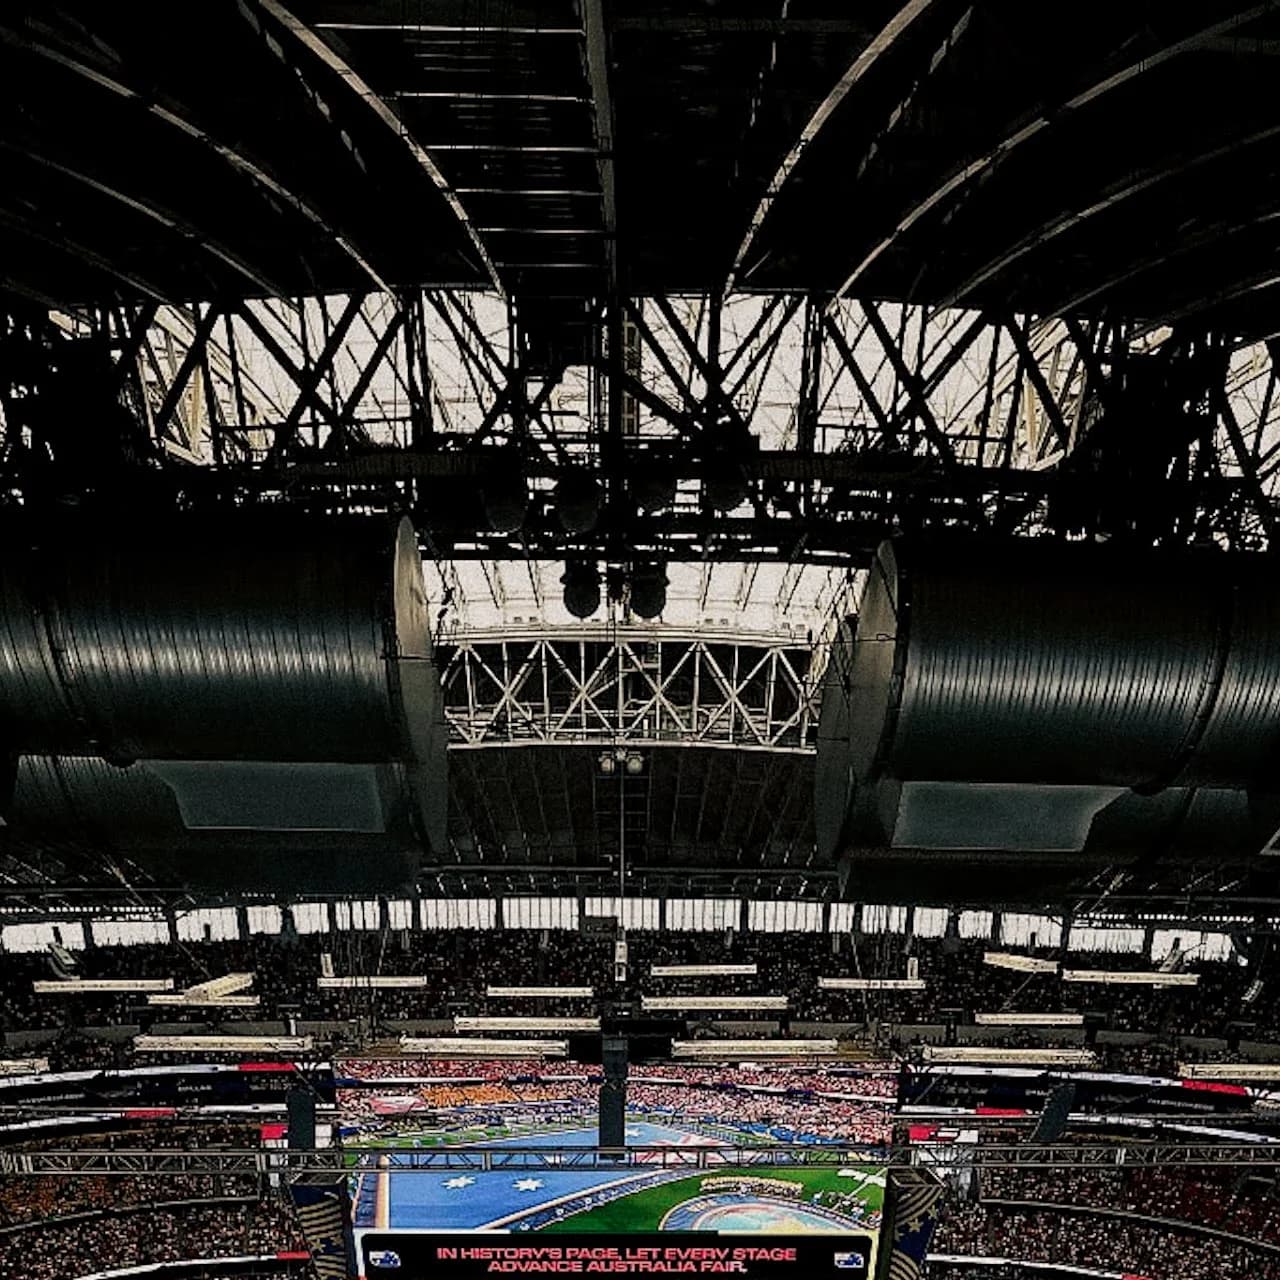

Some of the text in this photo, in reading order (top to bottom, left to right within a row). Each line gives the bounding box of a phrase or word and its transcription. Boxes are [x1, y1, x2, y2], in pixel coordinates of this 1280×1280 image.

[436, 1247, 797, 1261] IN HISTORY'S PAGE, LET EVERY STAGE
[487, 1260, 583, 1273] ADVANCE
[586, 1260, 698, 1273] AUSTRALIA
